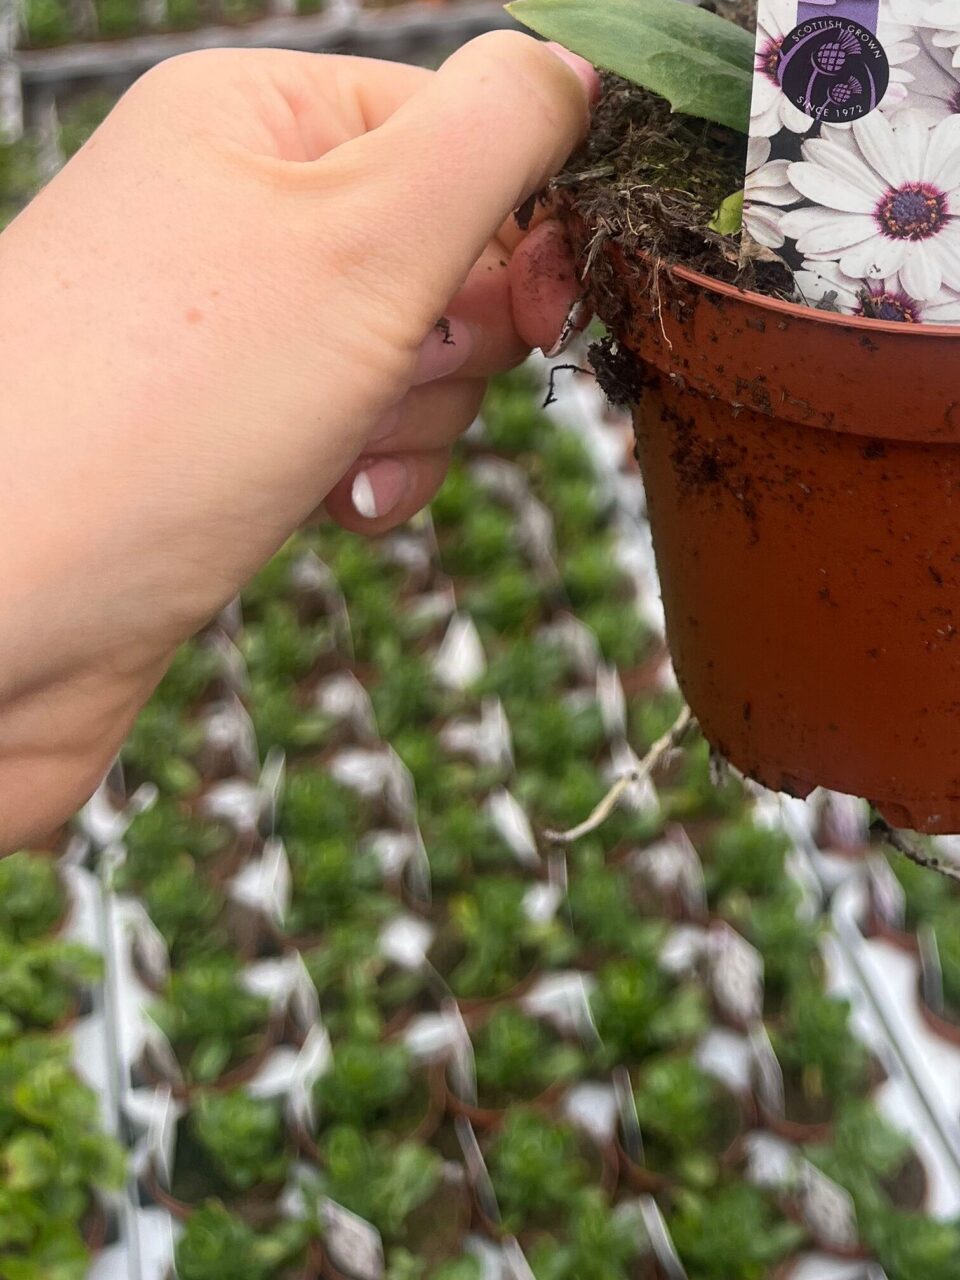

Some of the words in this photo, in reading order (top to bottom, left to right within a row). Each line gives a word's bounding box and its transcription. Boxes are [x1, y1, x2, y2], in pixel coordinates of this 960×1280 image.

[792, 20, 842, 42] SCOTTISH
[847, 25, 882, 59] GROWN
[796, 96, 829, 117] SINCE
[836, 106, 863, 118] 1972
